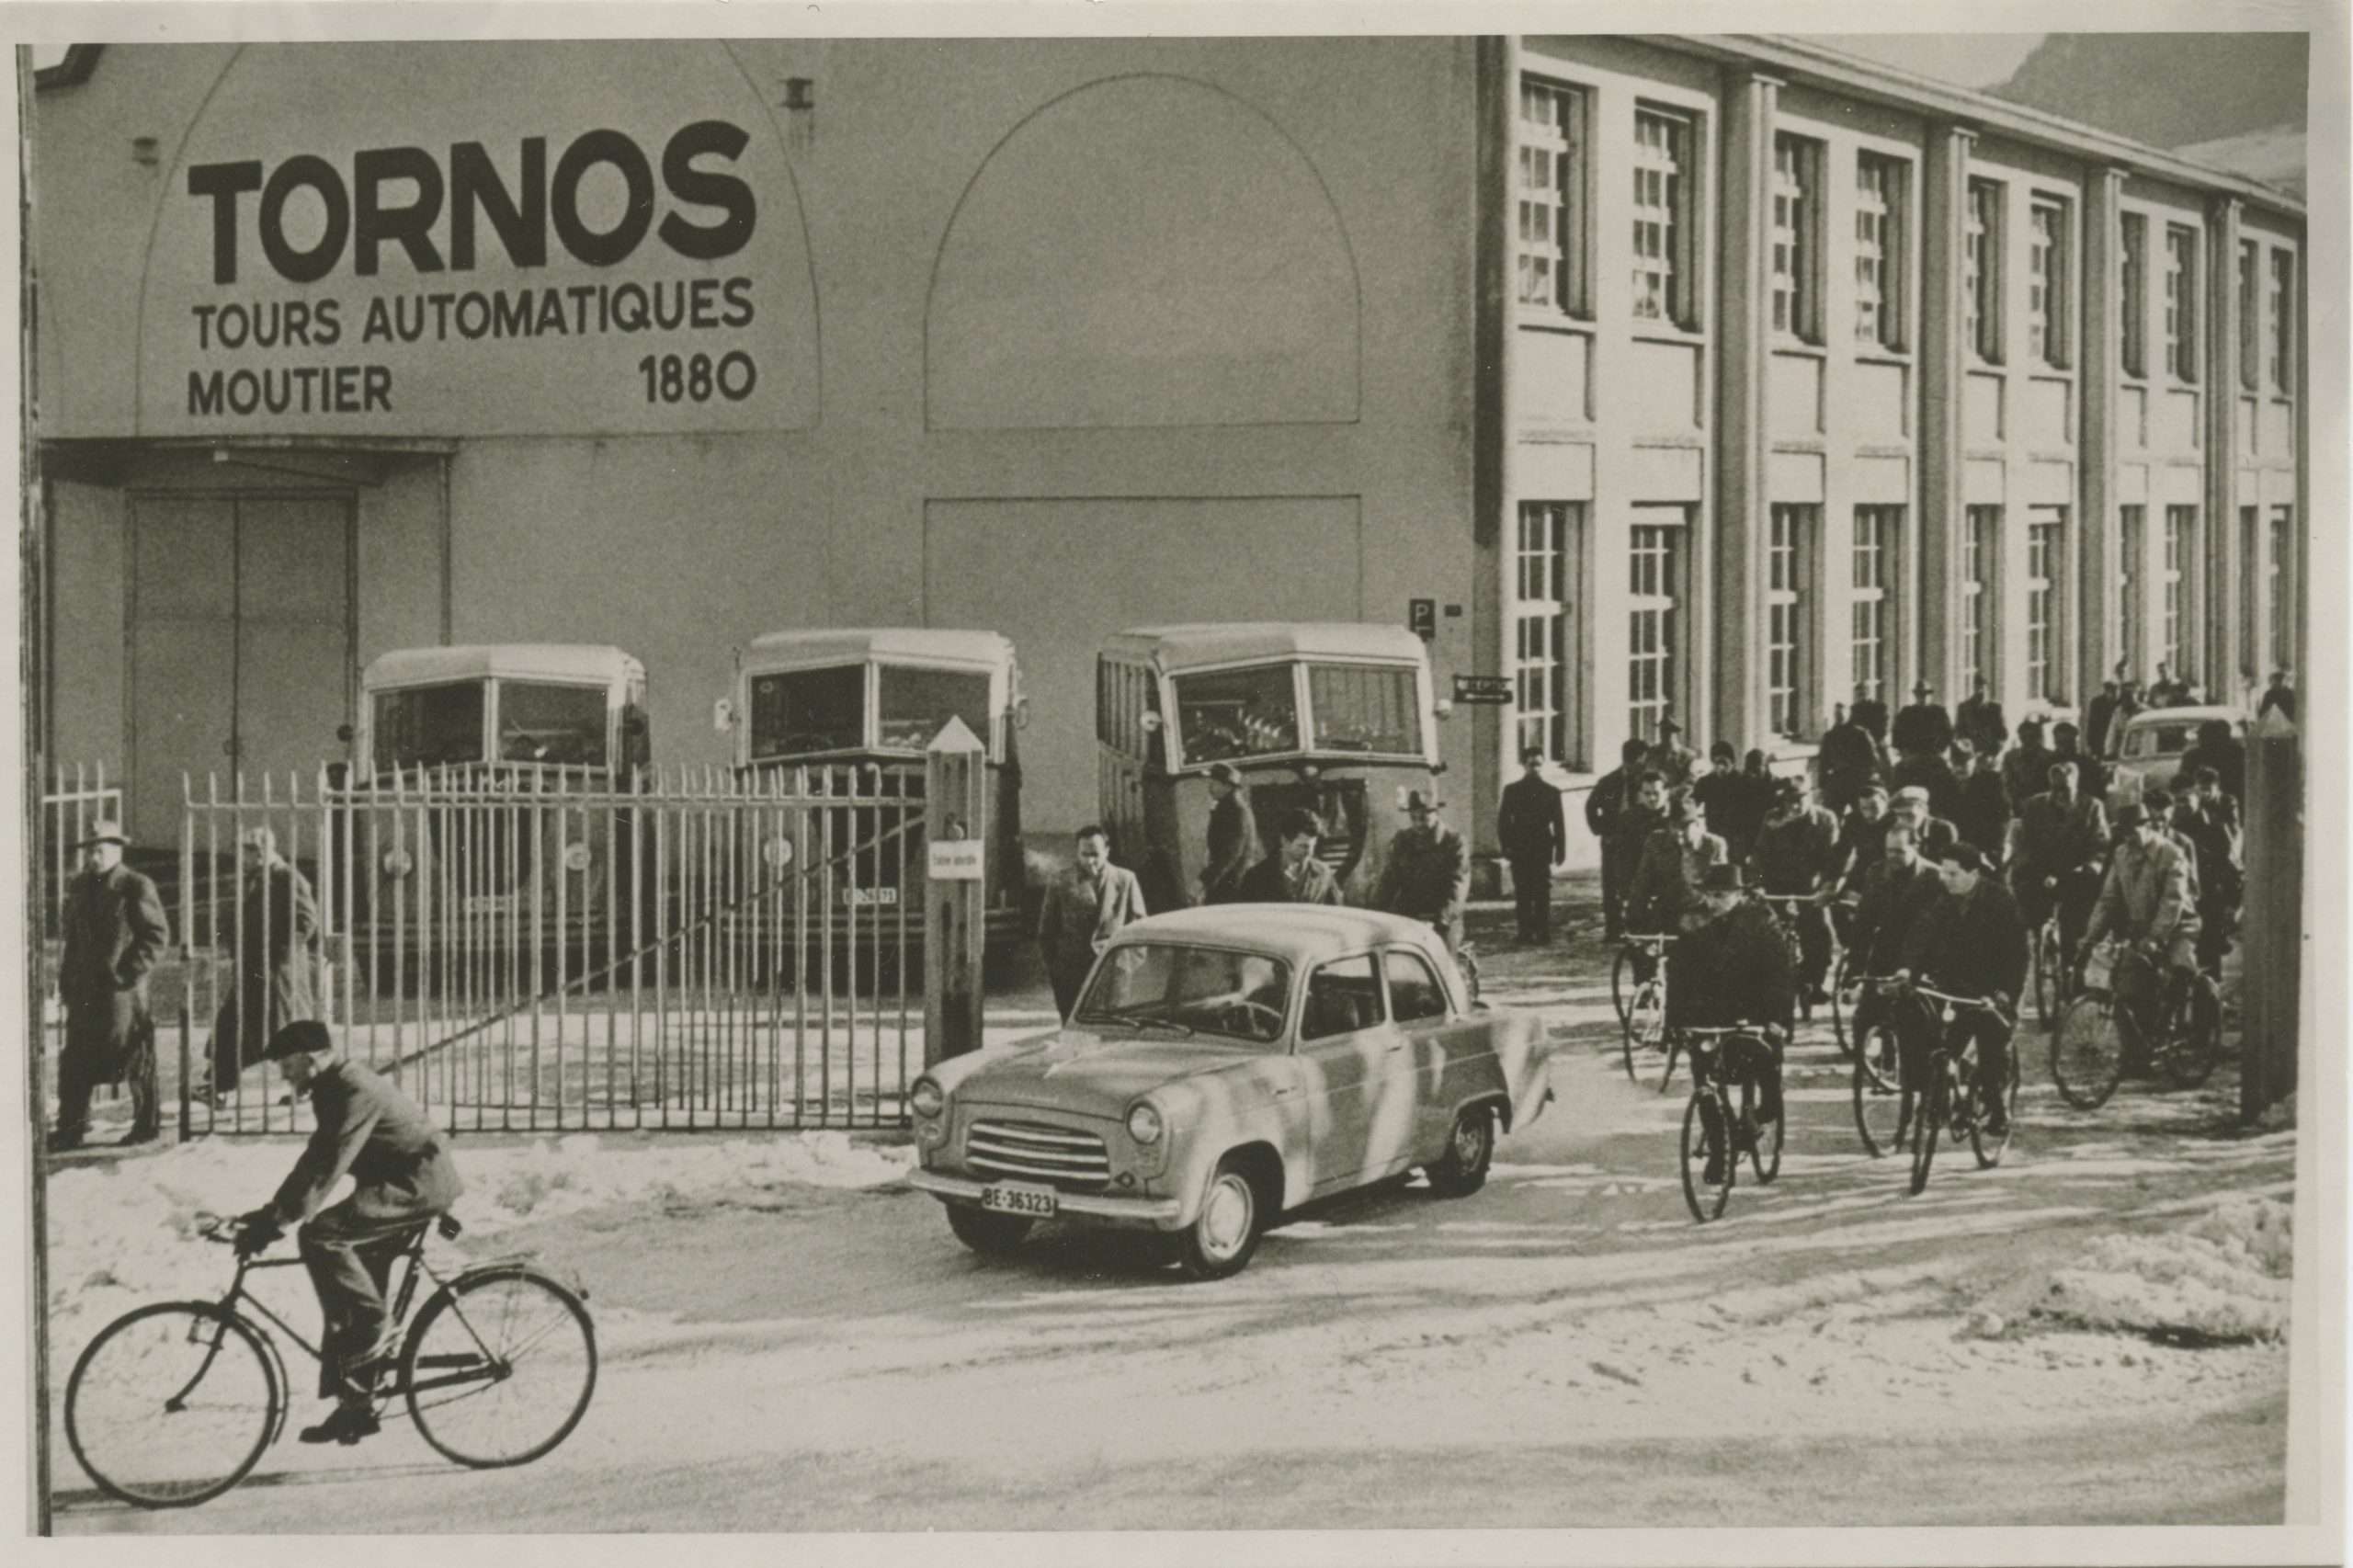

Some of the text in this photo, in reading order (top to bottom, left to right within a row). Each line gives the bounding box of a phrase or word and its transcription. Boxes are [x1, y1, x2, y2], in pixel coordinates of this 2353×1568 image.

[188, 119, 757, 286] TORNOS
[191, 277, 755, 349] TOURS AUTOMATIQUES
[188, 350, 756, 415] MOUTIER 1880
[1415, 603, 1428, 622] P
